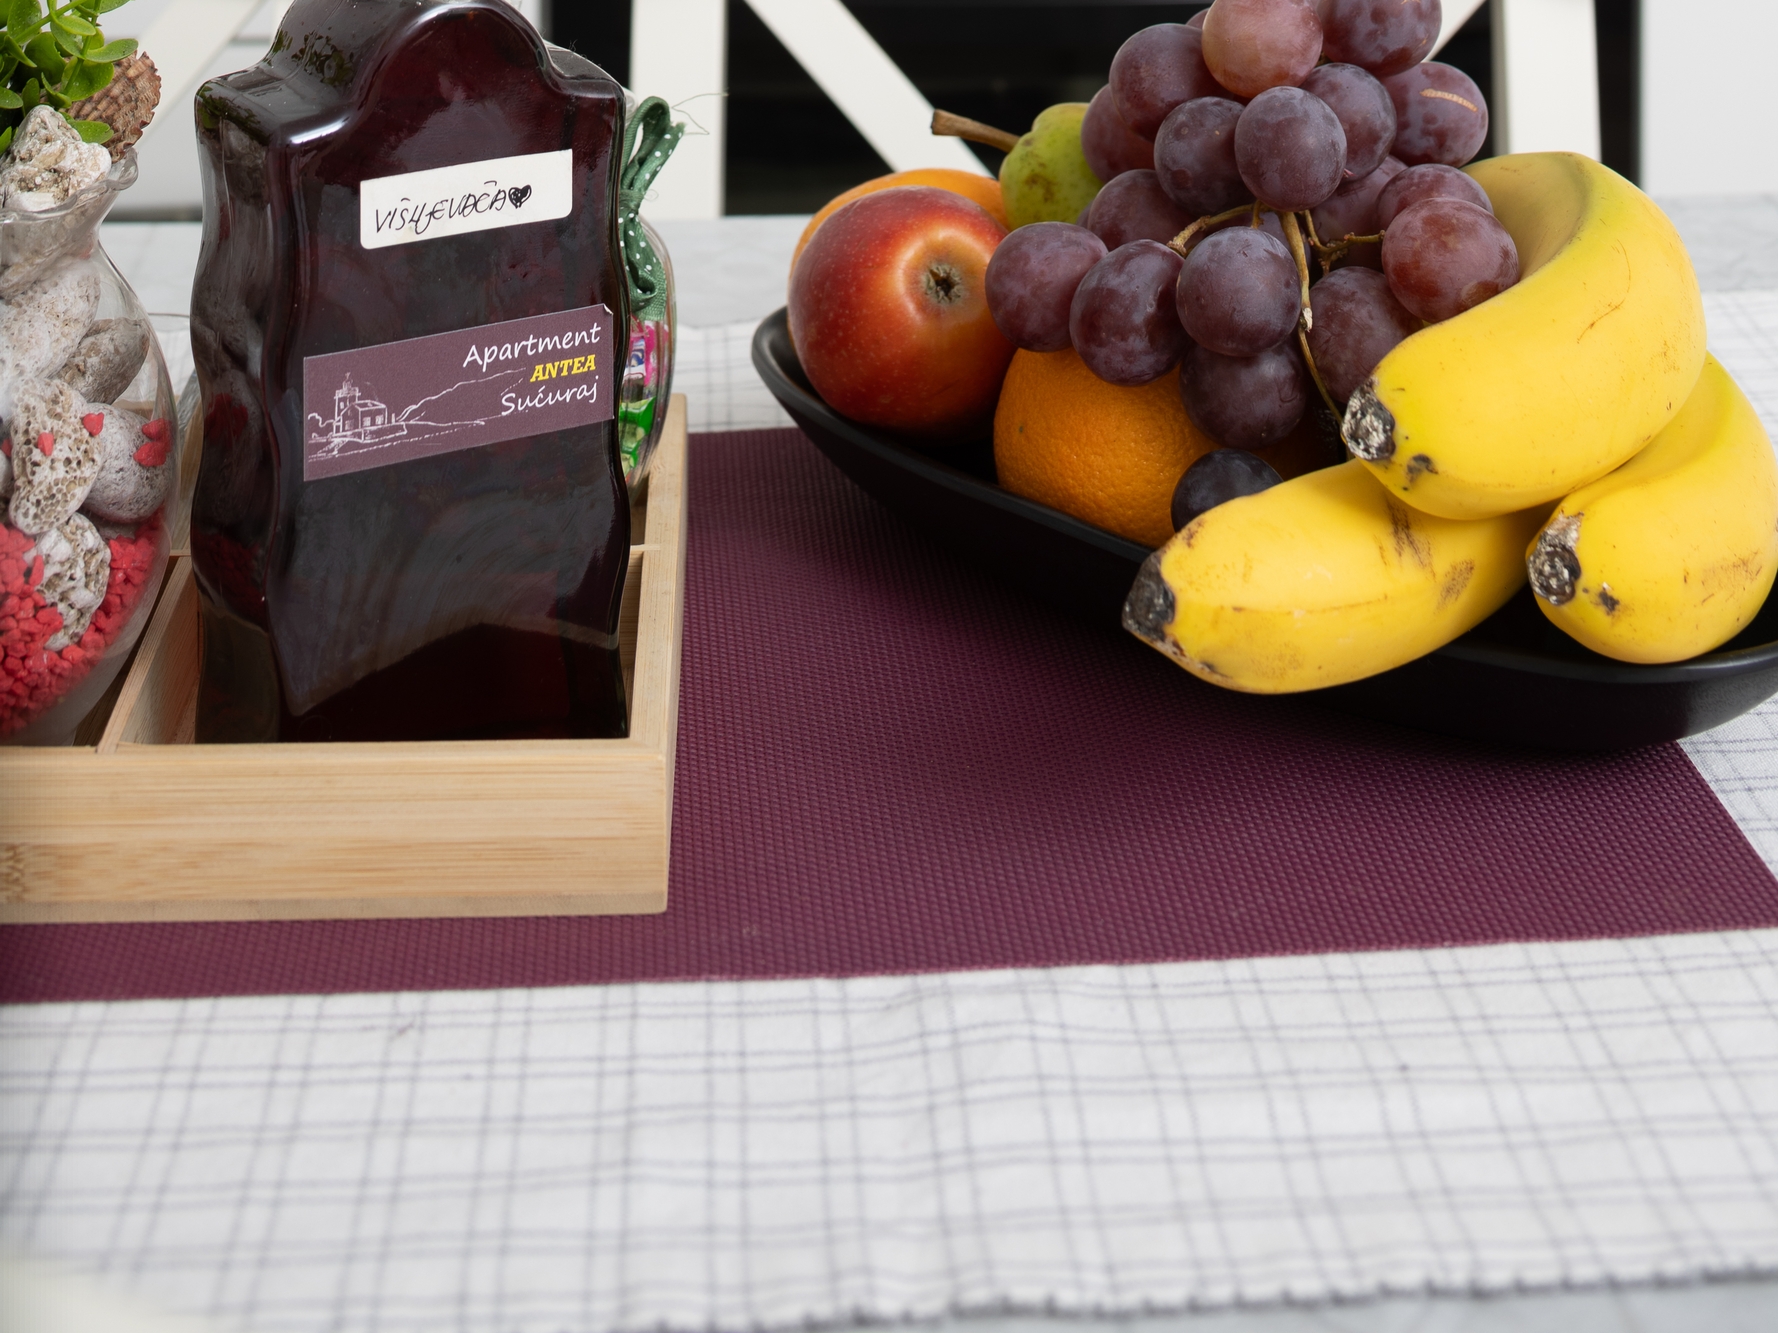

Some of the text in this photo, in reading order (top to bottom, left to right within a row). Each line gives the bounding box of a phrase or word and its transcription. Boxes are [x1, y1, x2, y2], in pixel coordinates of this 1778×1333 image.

[463, 322, 601, 372] Apartment
[530, 354, 597, 383] ANTEA
[501, 375, 599, 416] Sućuraj
